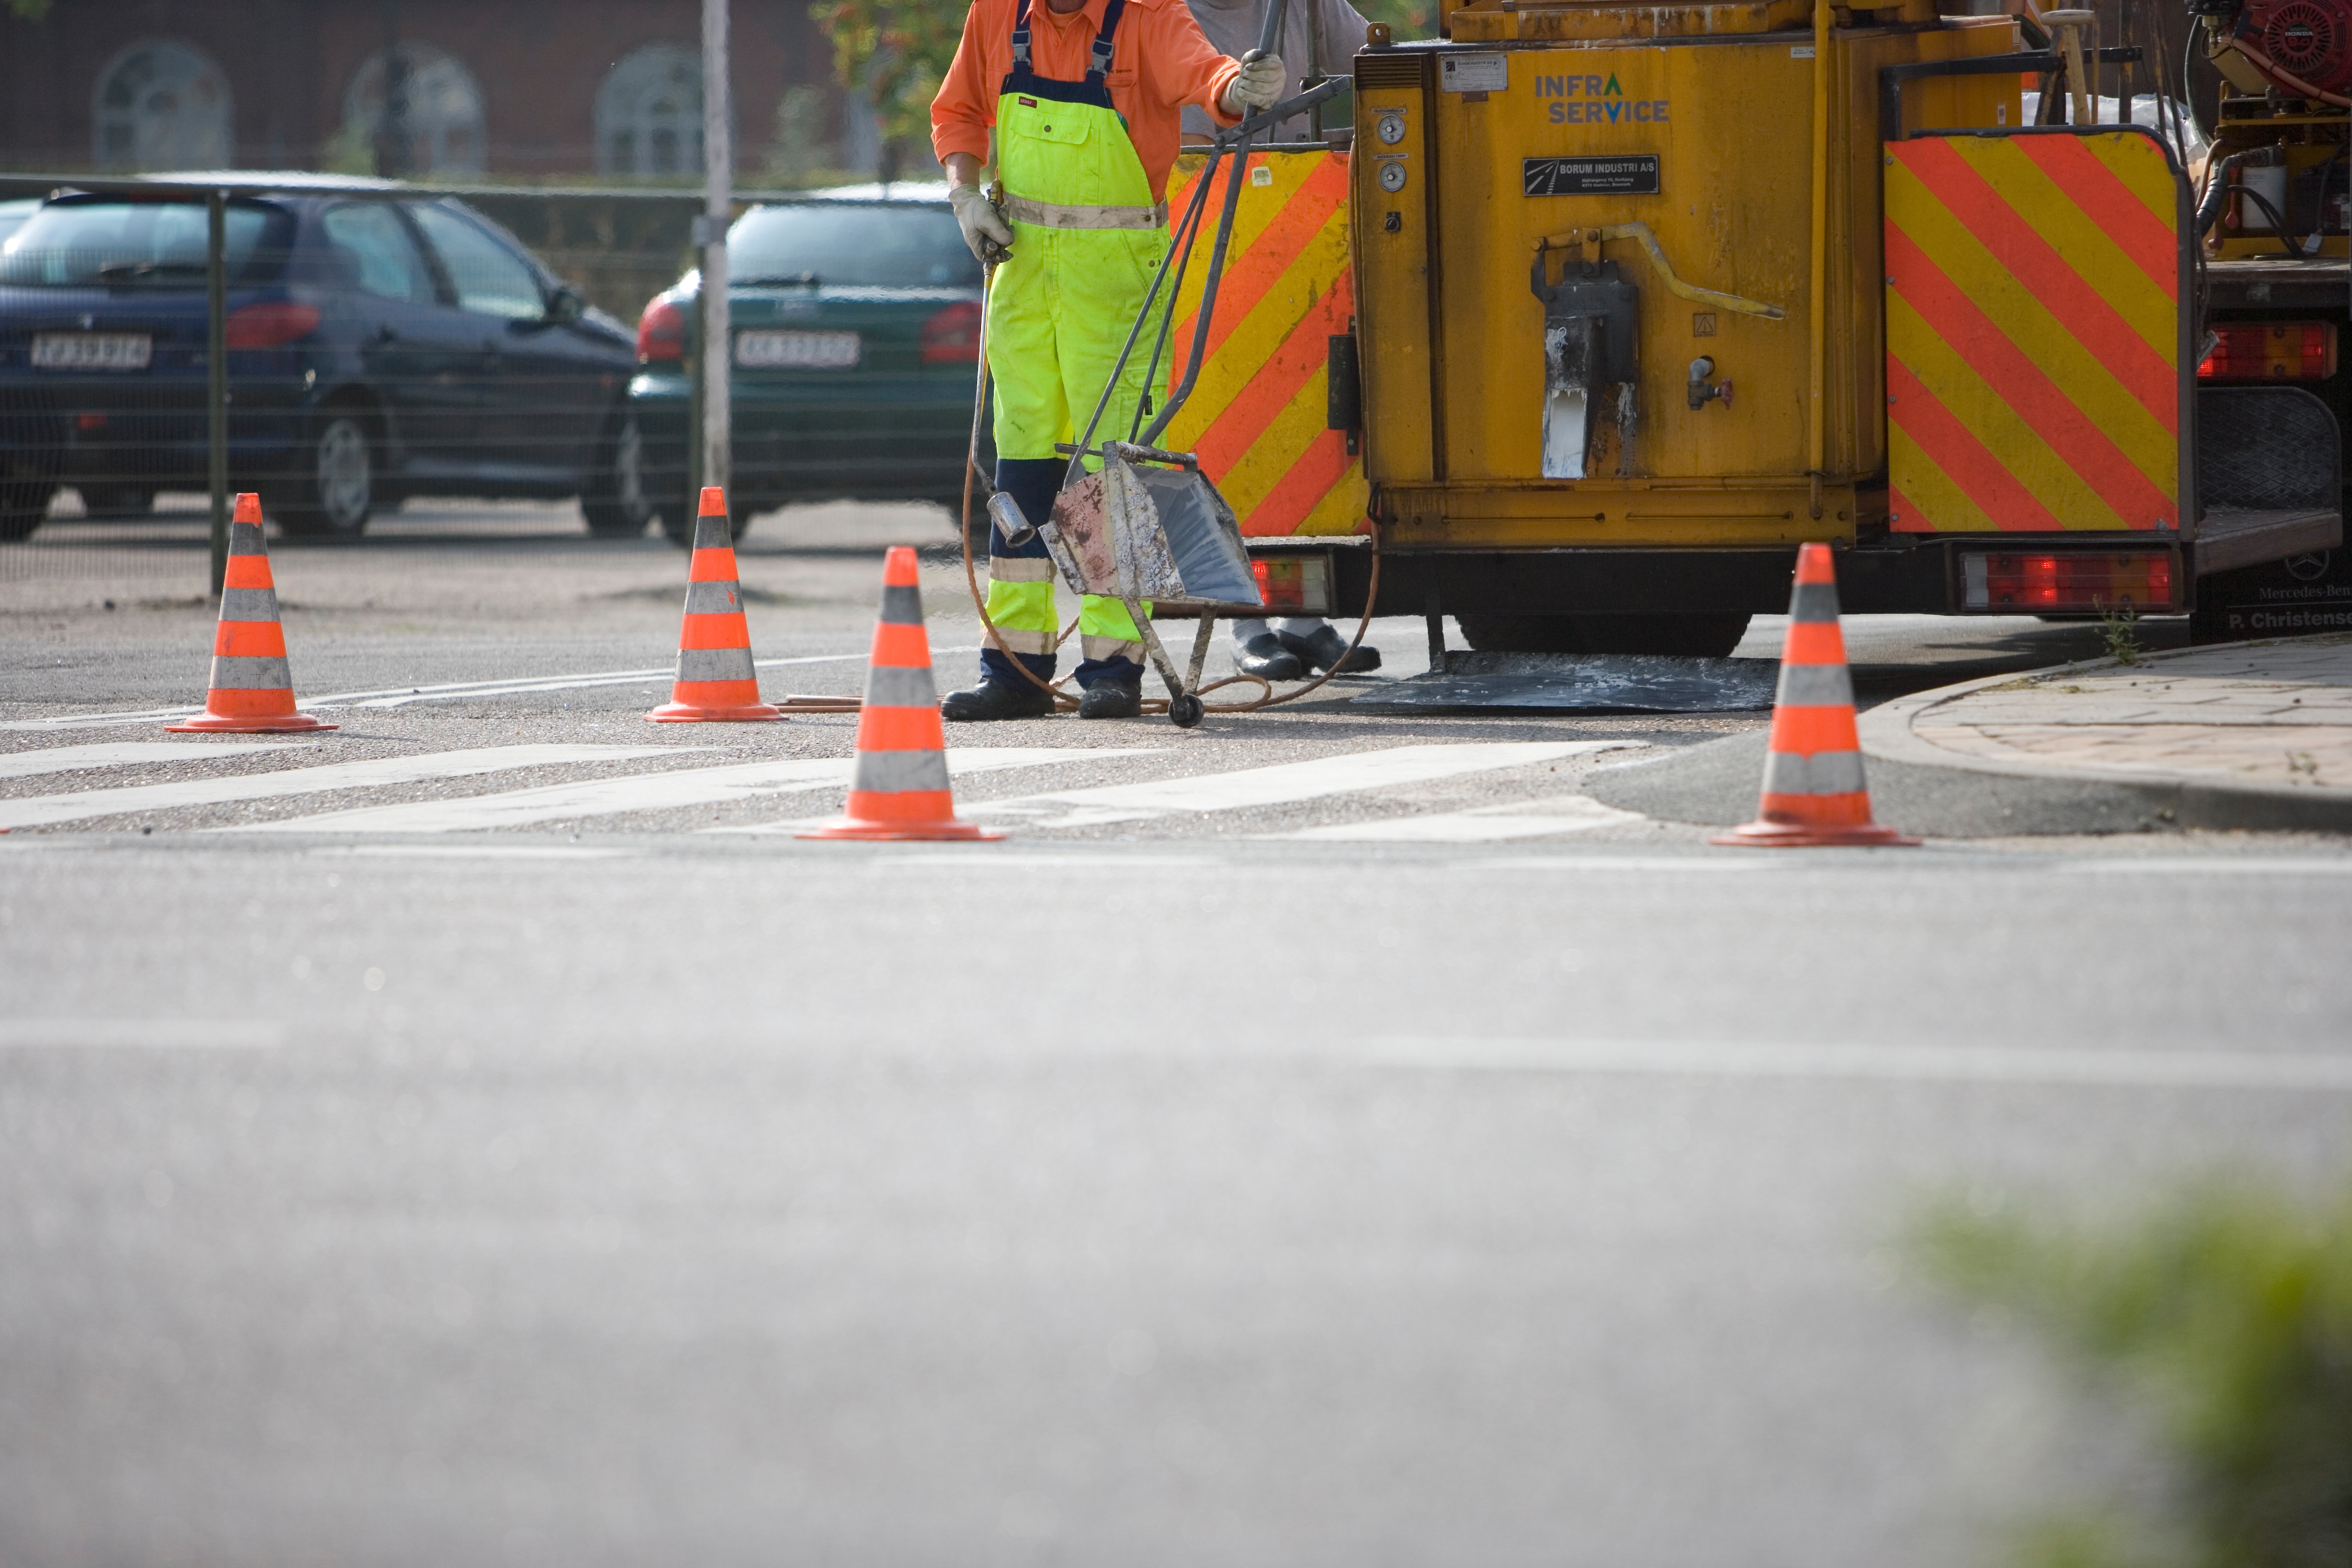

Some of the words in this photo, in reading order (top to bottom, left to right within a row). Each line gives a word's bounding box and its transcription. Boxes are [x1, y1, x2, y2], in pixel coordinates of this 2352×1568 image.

[1535, 72, 1623, 98] INFRA
[1548, 100, 1669, 125] SERVICE
[1560, 164, 1592, 174] BORUM
[1595, 163, 1637, 173] INDUSTRI
[1640, 163, 1655, 172] A/S
[2260, 585, 2352, 600] Mercedes-Ben
[2229, 614, 2245, 629] P.
